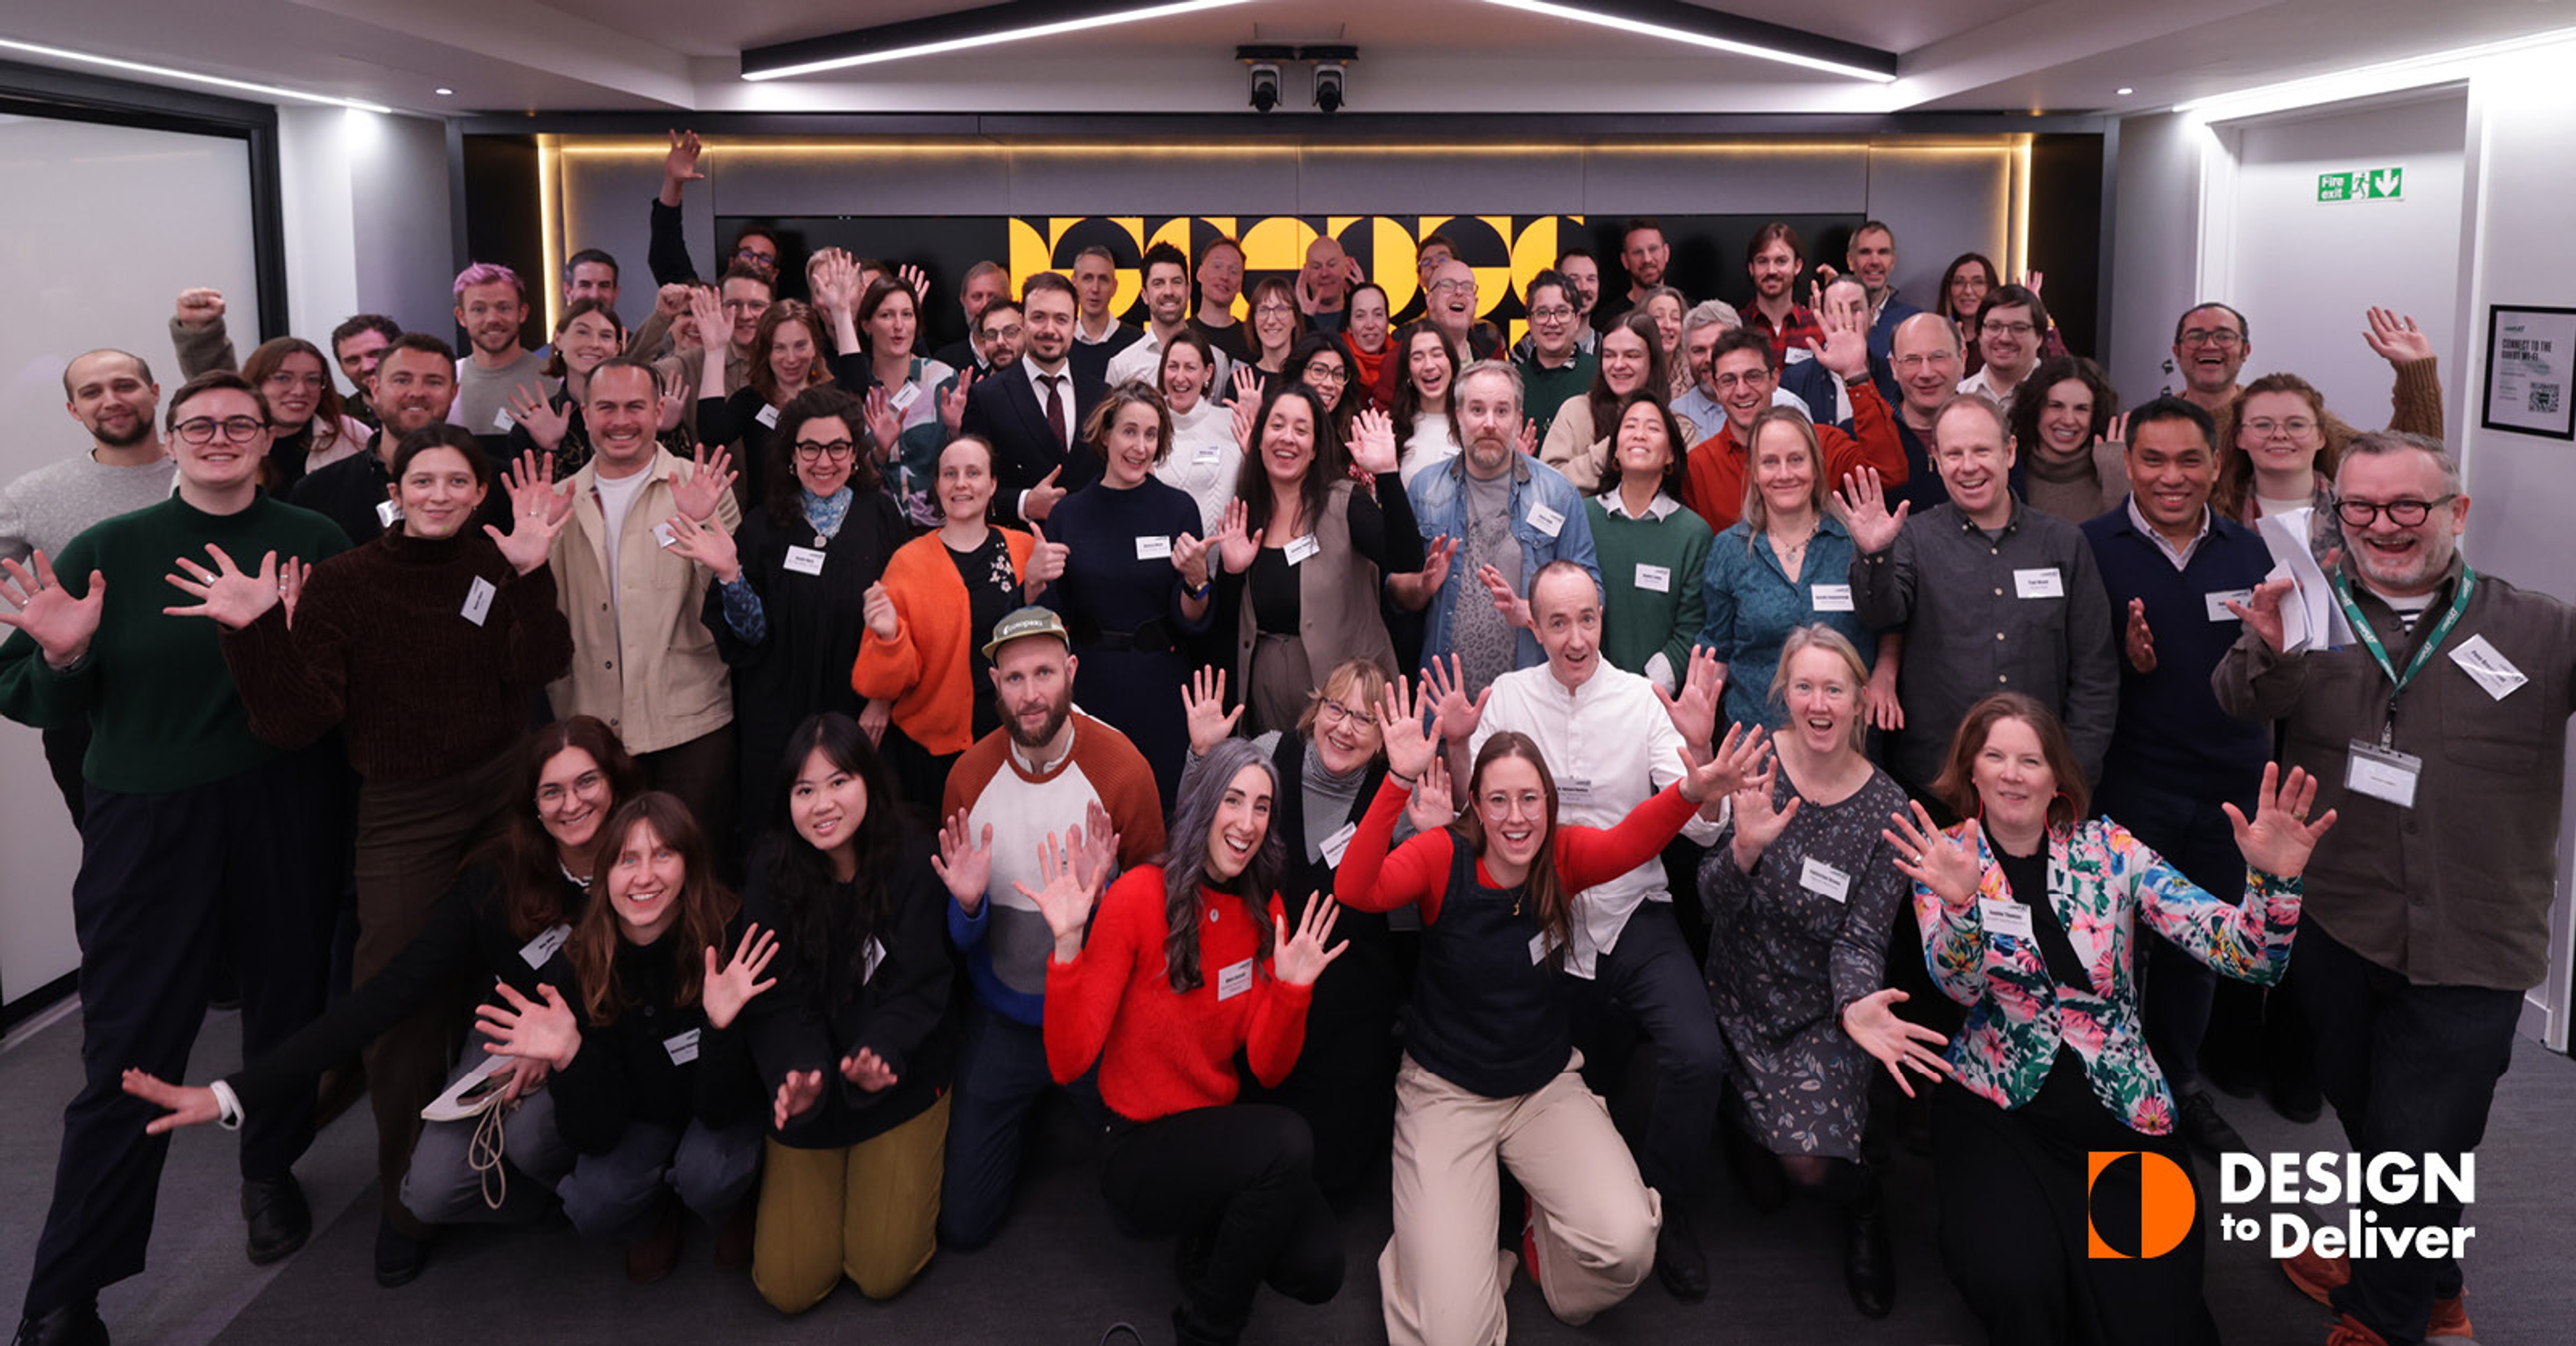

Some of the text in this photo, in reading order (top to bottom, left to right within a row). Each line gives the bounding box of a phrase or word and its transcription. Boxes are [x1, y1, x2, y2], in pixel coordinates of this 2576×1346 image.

[2322, 176, 2344, 188] Fire
[2321, 188, 2343, 199] exit
[2531, 340, 2539, 352] TO
